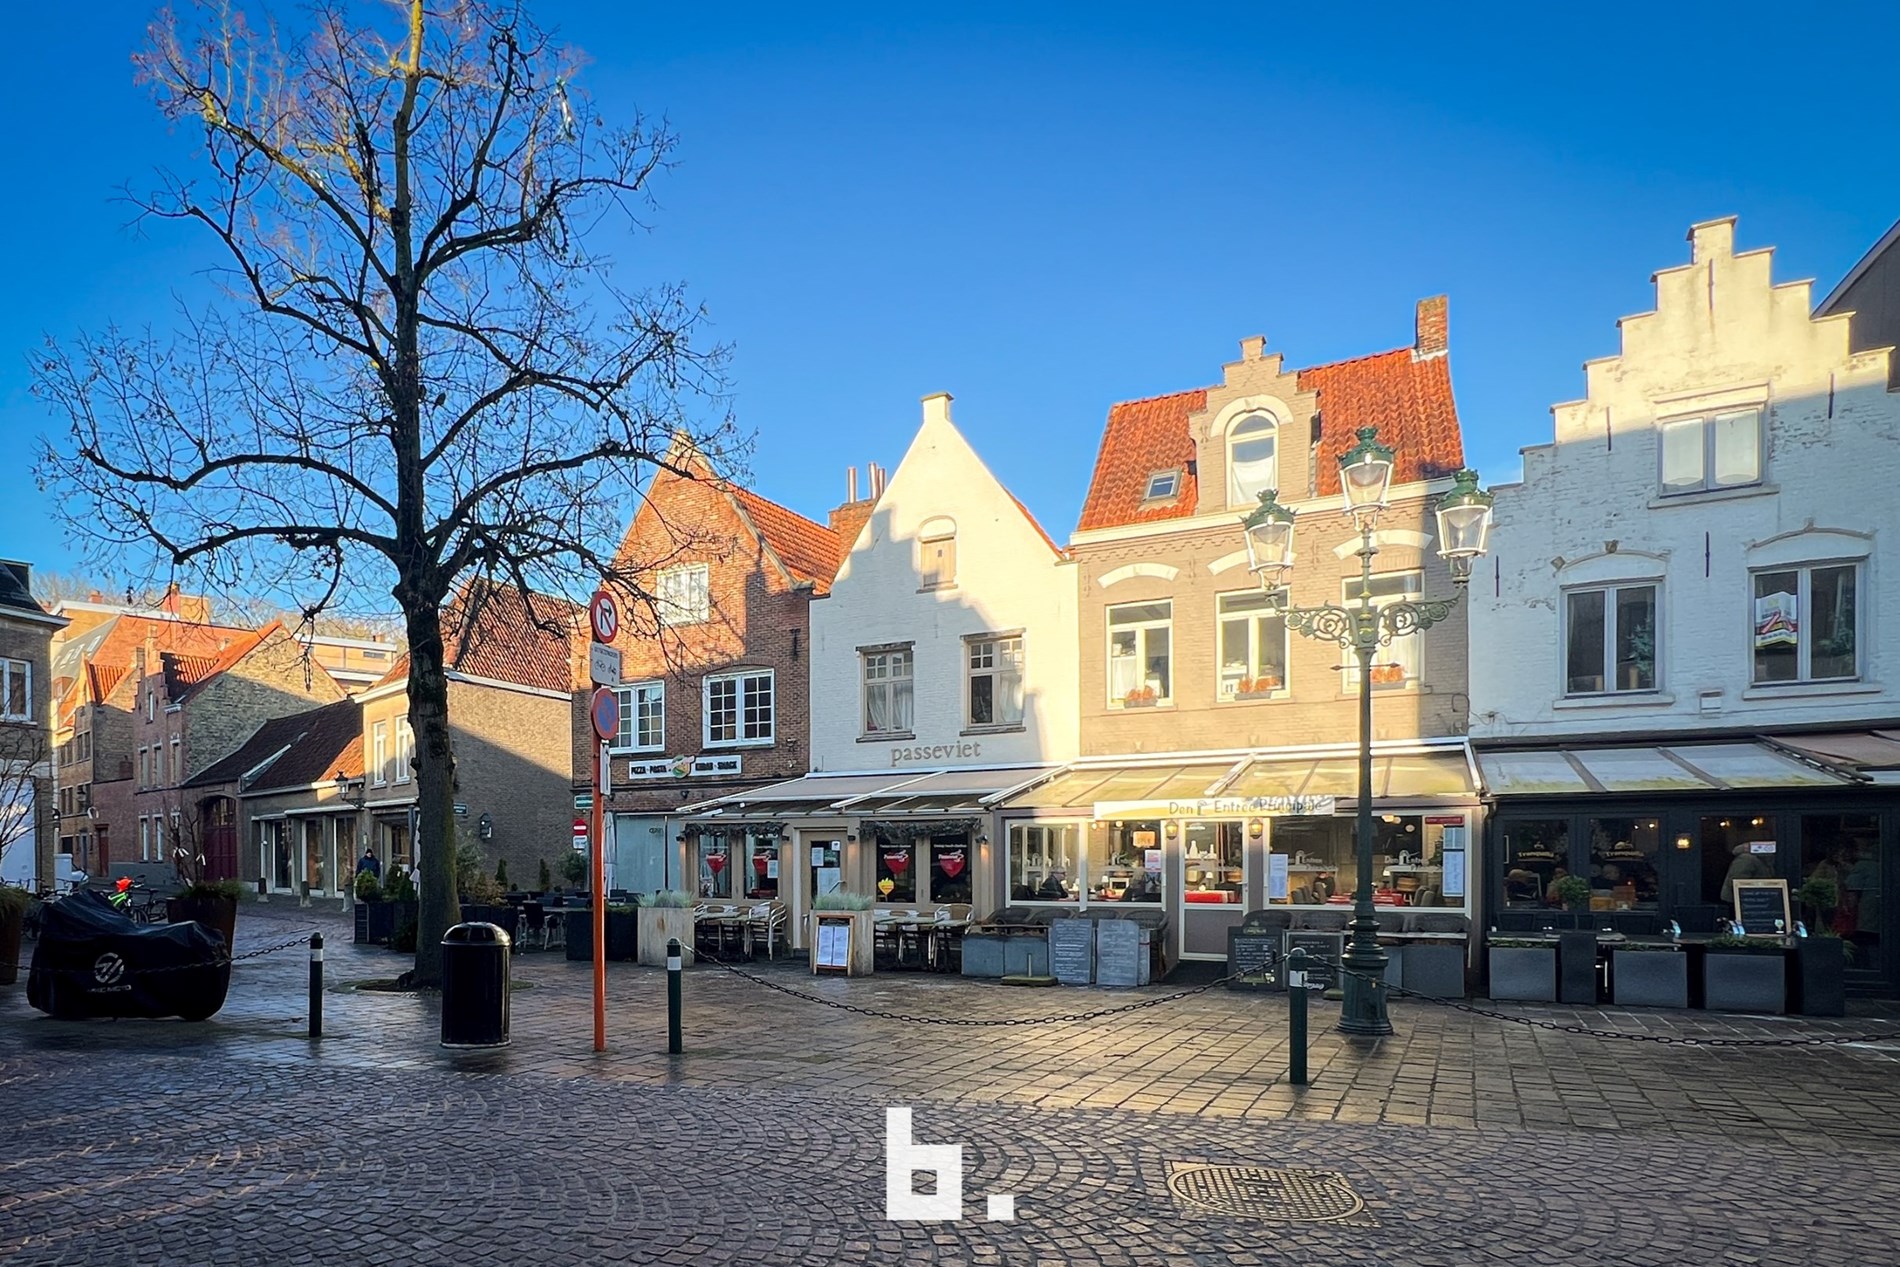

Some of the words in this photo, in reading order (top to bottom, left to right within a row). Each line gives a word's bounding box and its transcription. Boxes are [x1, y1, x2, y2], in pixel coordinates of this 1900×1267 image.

[891, 741, 981, 767] passeviet
[631, 766, 646, 774] PIZZA
[650, 765, 667, 774] PASTA
[1169, 801, 1193, 815] Den
